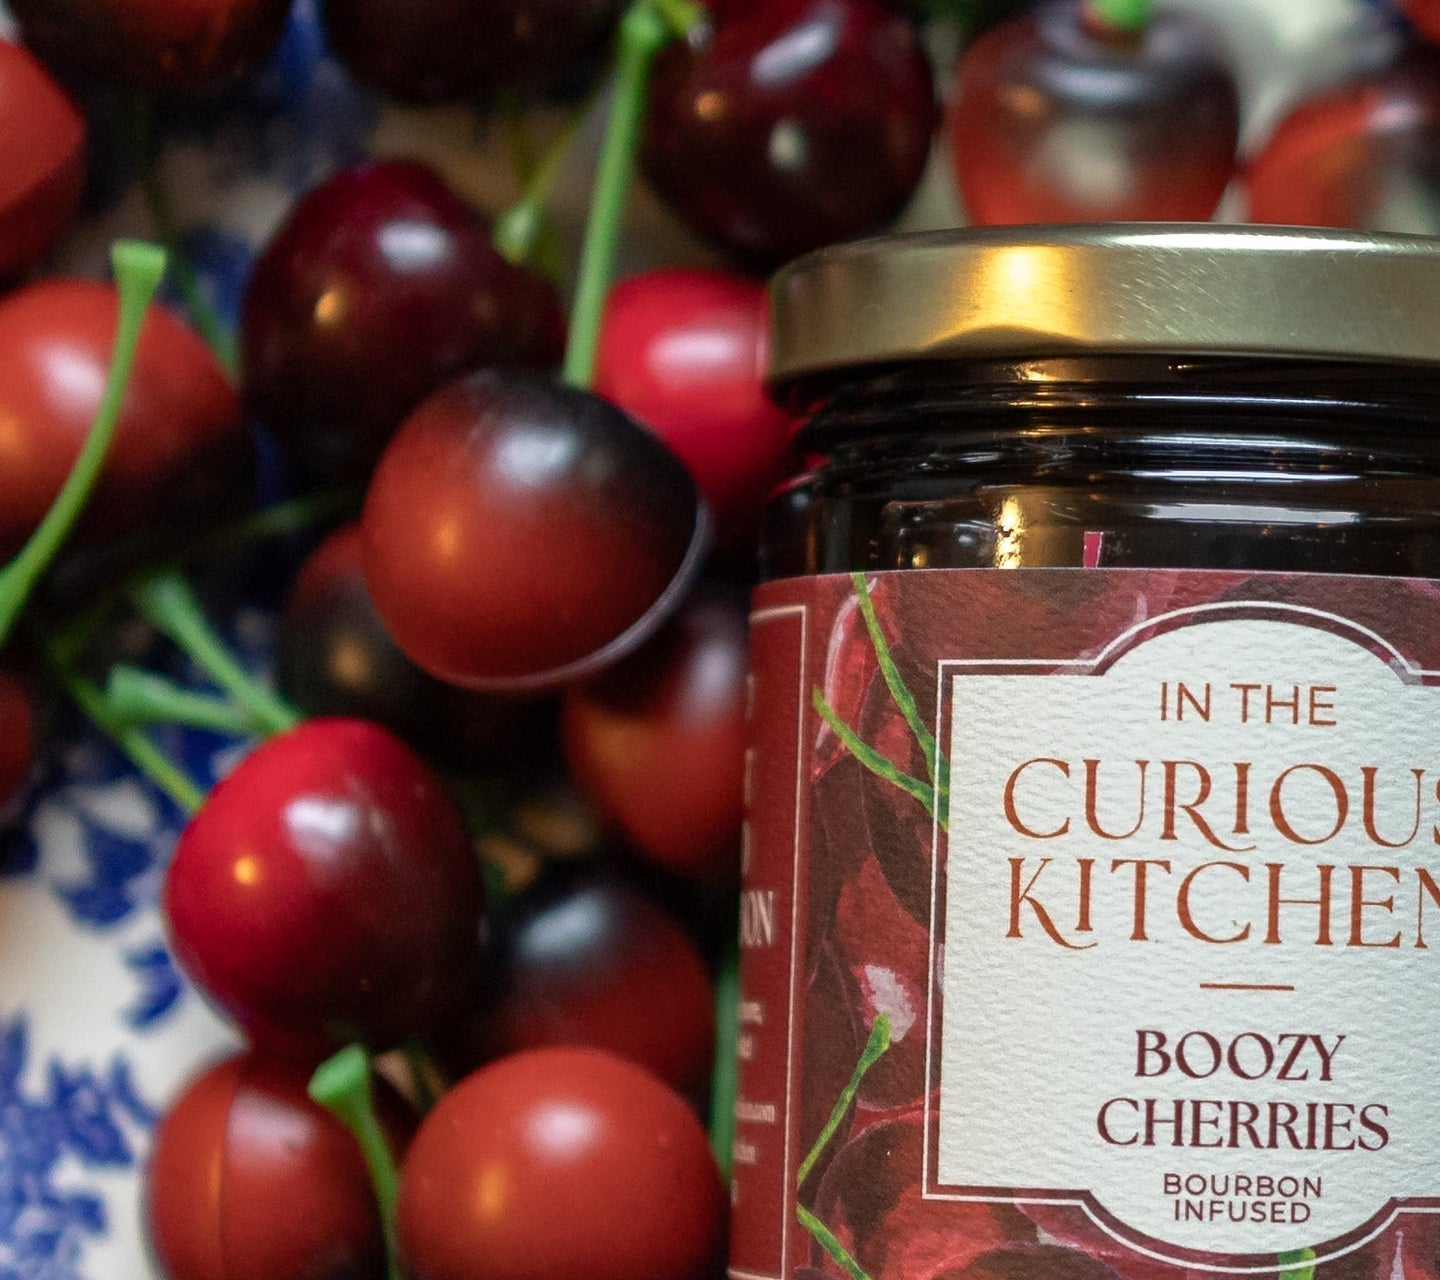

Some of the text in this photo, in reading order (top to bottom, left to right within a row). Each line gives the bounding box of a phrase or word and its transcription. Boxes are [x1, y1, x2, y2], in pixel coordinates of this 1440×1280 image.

[1161, 682, 1337, 726] IN THE
[1134, 1029, 1346, 1081] BOOZY
[1096, 1098, 1390, 1151] CHERRIES
[1163, 1173, 1322, 1198] BOURBON
[1174, 1199, 1311, 1223] INFUSED
